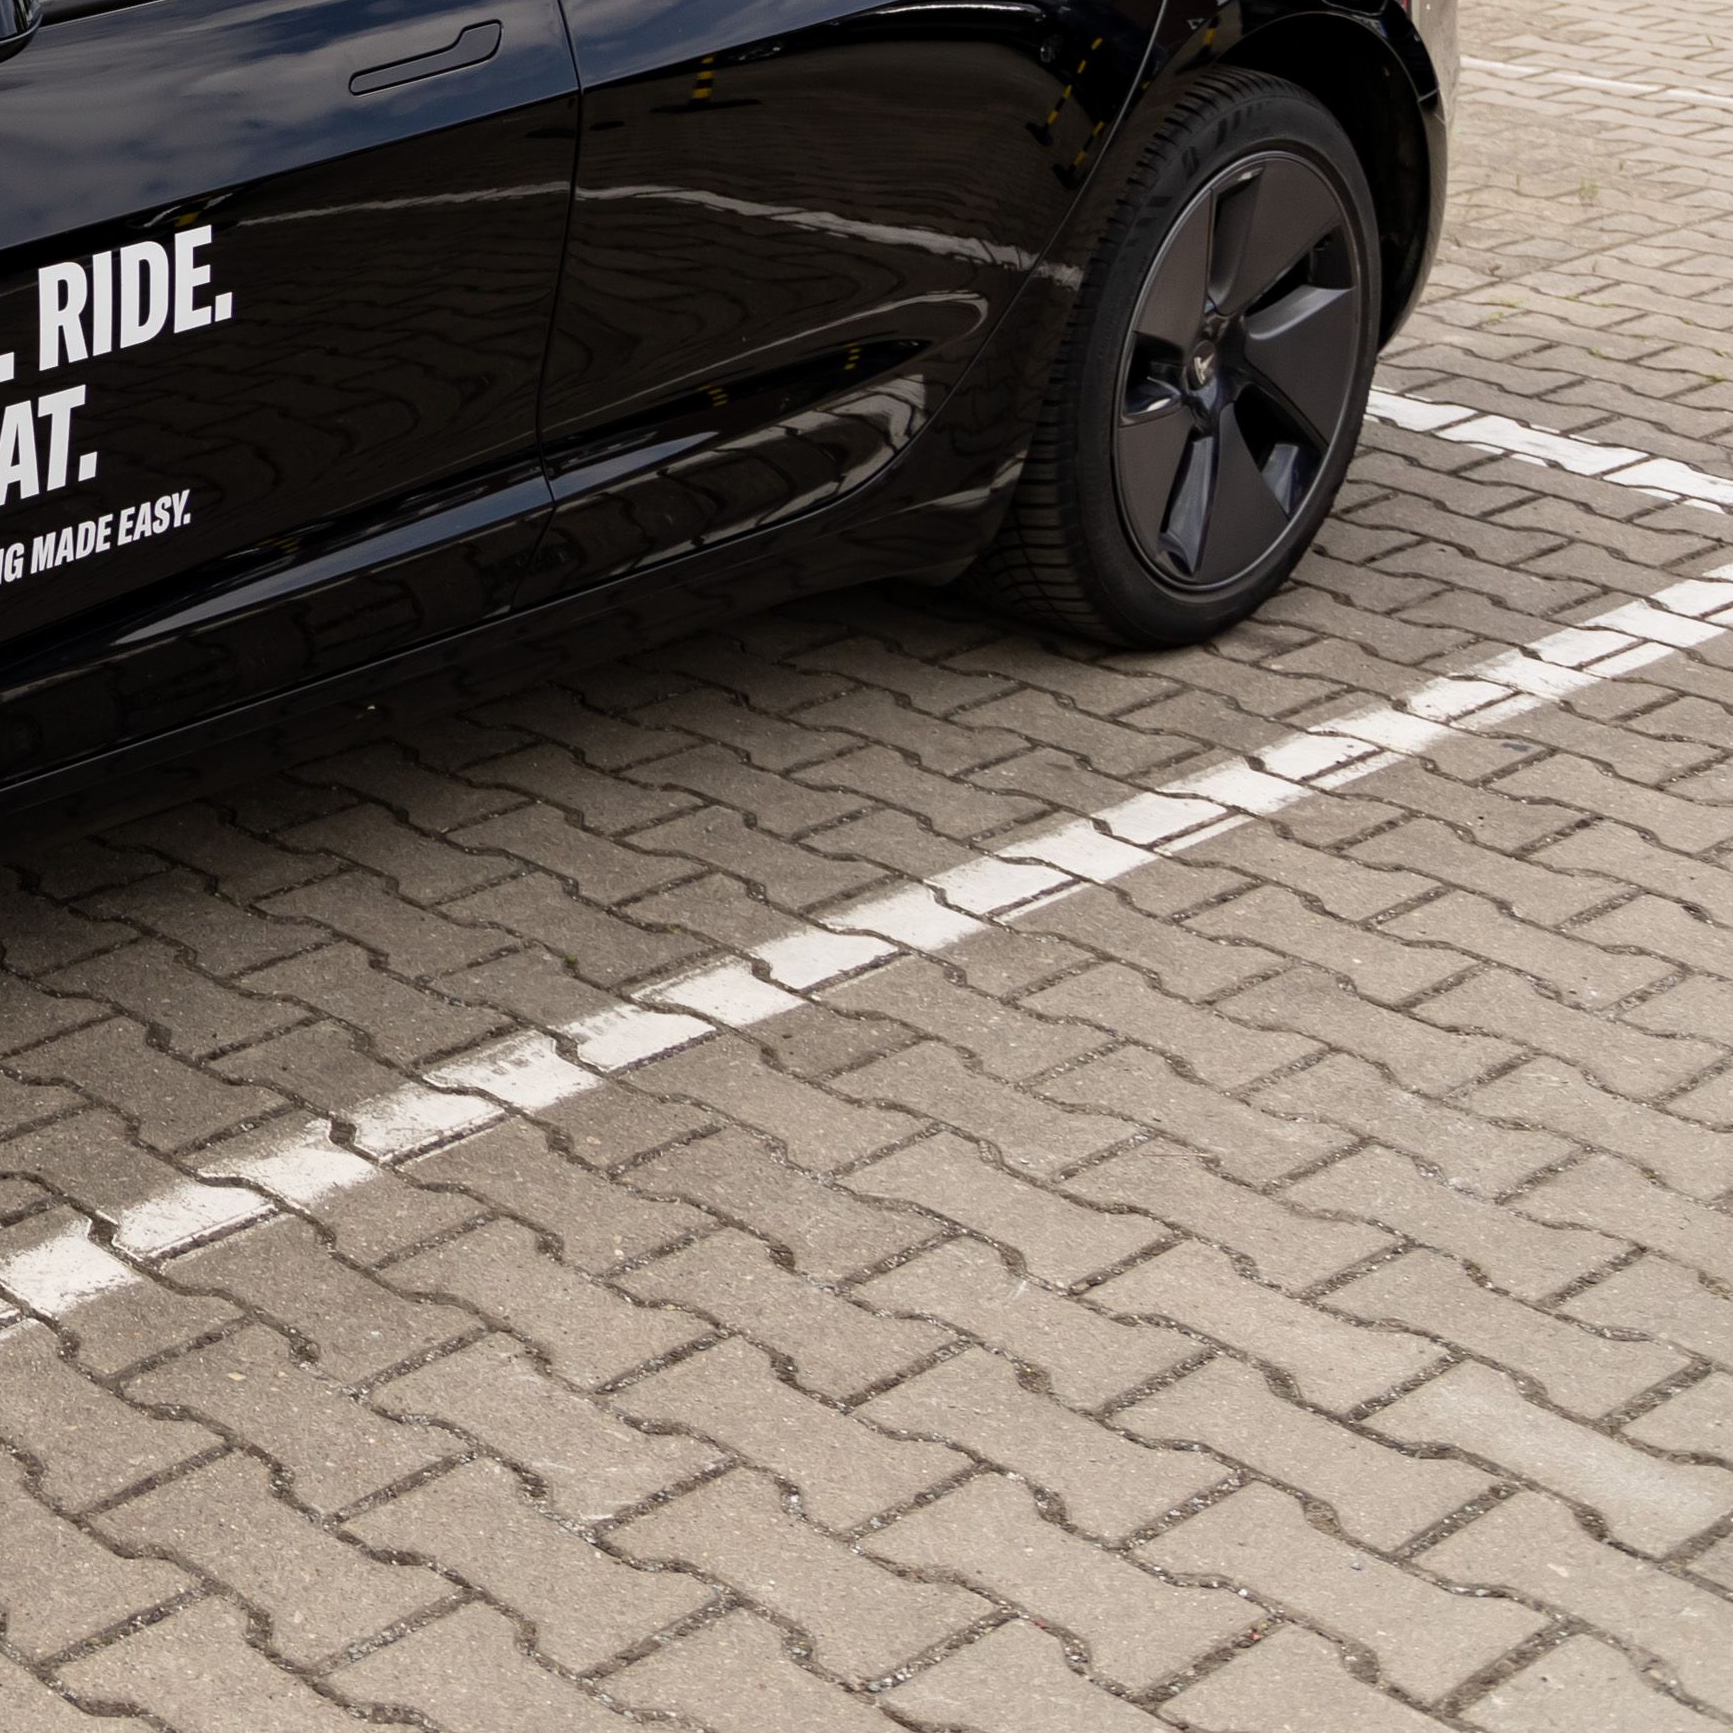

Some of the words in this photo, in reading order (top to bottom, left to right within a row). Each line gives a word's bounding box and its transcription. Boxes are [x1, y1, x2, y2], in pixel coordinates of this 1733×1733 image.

[38, 224, 234, 372] RIDE.
[30, 518, 112, 576] MADE
[116, 489, 192, 547] EASY.
